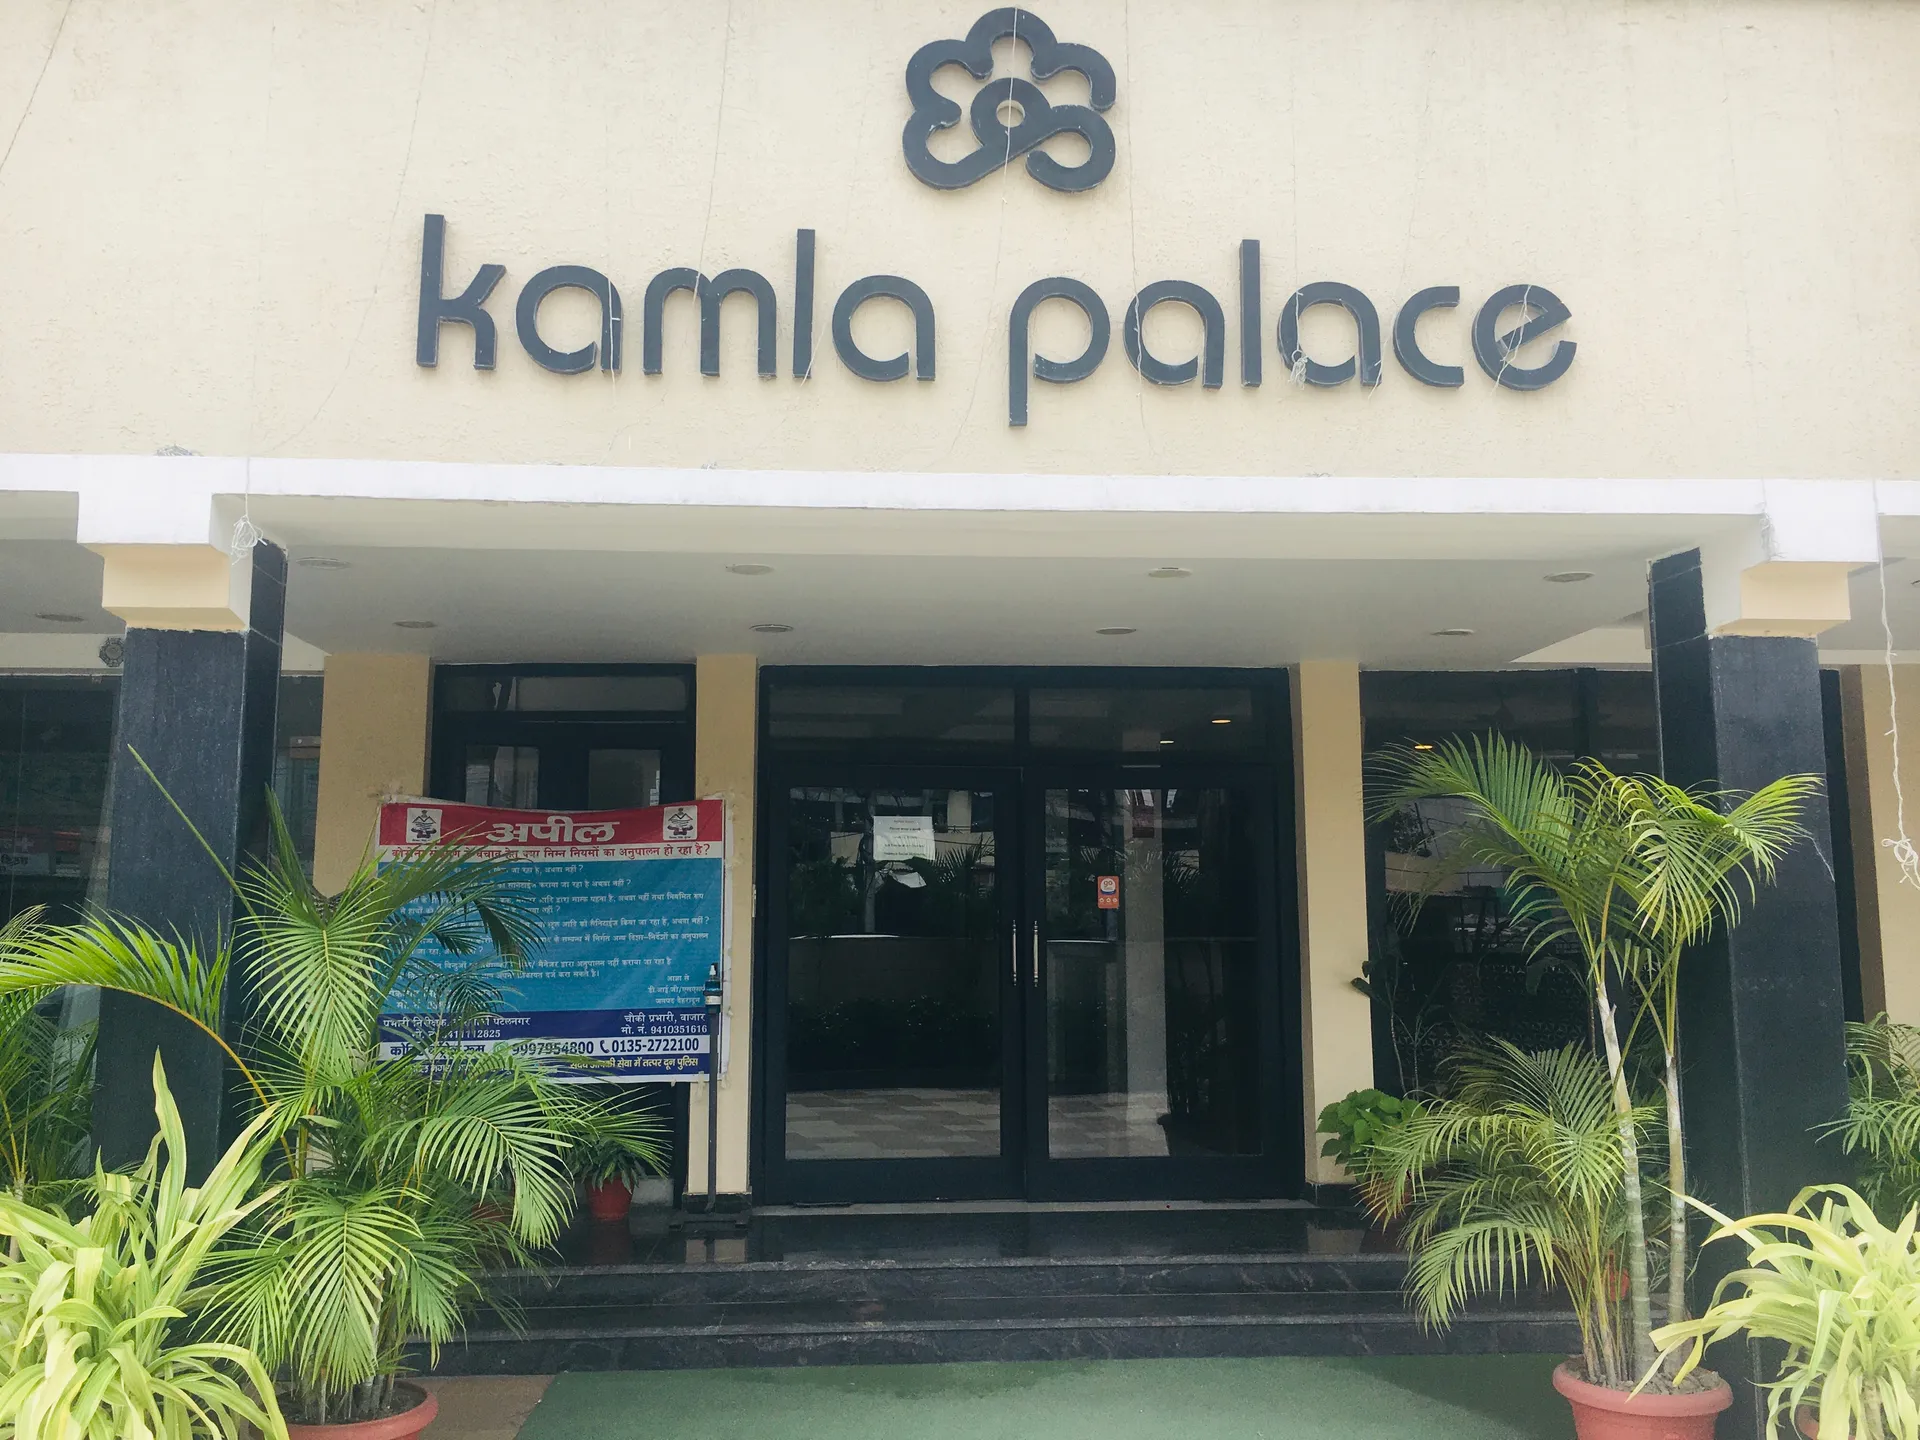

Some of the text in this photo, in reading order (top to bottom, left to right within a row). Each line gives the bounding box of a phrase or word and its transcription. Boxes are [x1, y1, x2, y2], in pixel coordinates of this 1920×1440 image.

[417, 213, 1577, 427] kamla palace
[486, 815, 620, 843] अपील
[544, 847, 566, 858] निम्न
[570, 845, 599, 858] नियमों
[603, 848, 615, 857] का
[619, 847, 660, 860] अनुपालन
[664, 844, 673, 856] हो
[677, 846, 692, 856] रहा
[624, 1011, 645, 1023] चौकी
[649, 1011, 677, 1024] प्रभारी,
[621, 1024, 634, 1035] मो.
[650, 1024, 707, 1035] 9410351616
[612, 1037, 699, 1054] 0135-2722100
[634, 1056, 642, 1067] में
[677, 1055, 698, 1071] पुलिस
